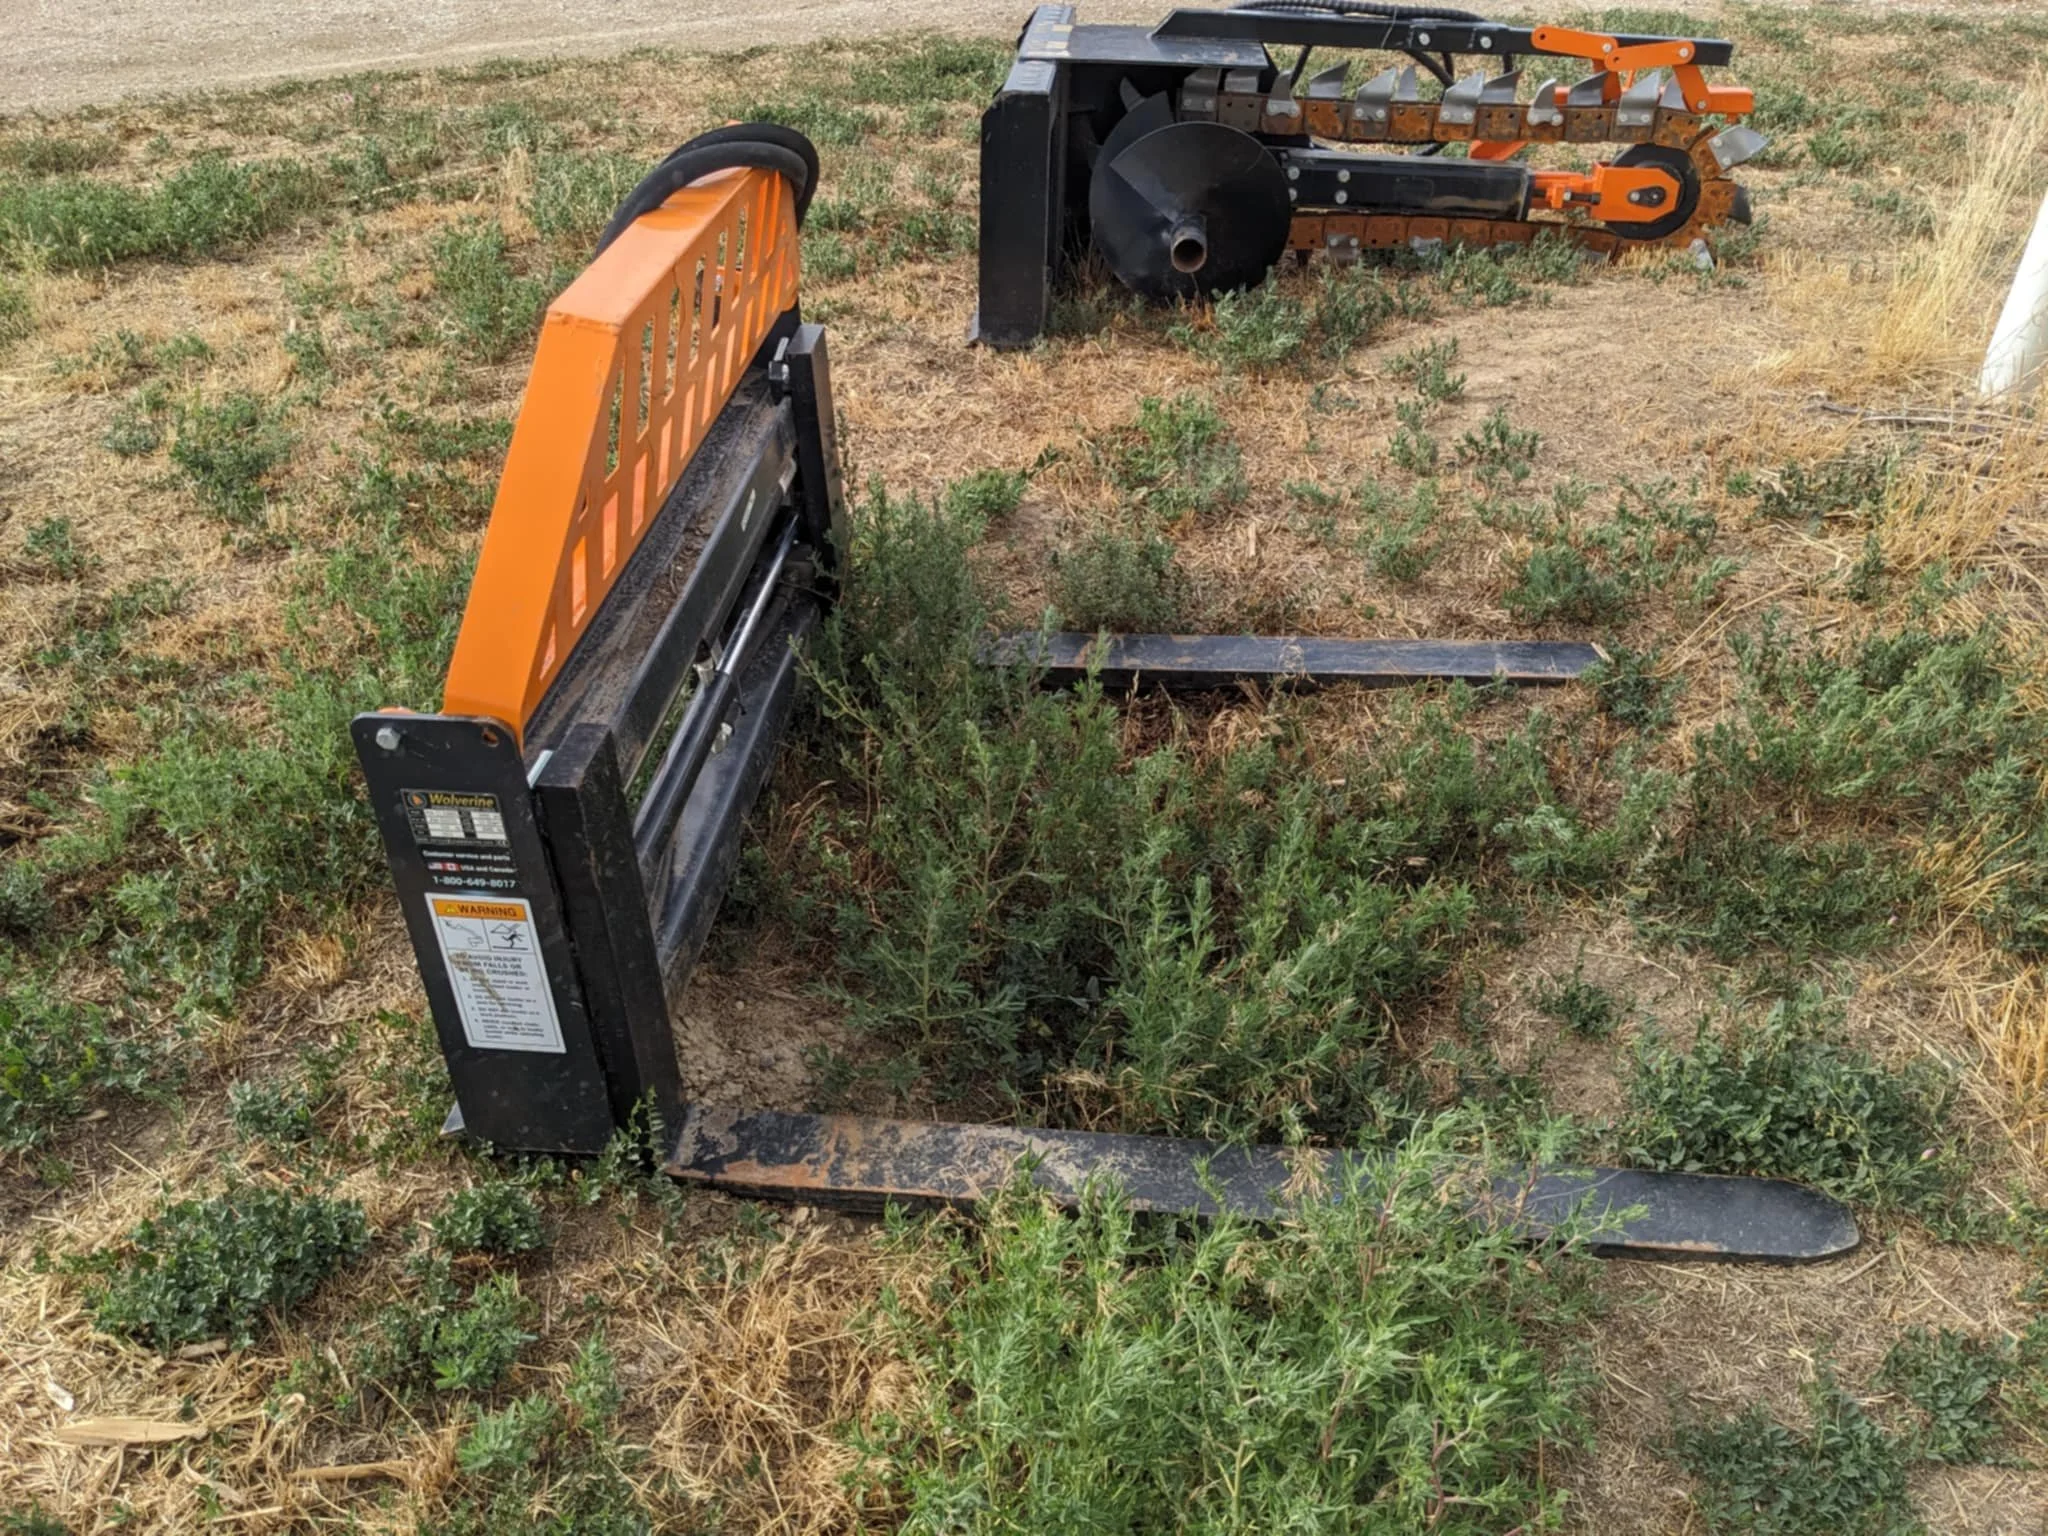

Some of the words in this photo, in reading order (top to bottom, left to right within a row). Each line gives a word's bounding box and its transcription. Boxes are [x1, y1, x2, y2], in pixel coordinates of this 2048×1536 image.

[429, 792, 494, 807] Wolverine
[461, 864, 474, 872] USA
[475, 865, 488, 873] and
[432, 875, 516, 888] 1-800-649-8017
[457, 905, 517, 917] WARNING
